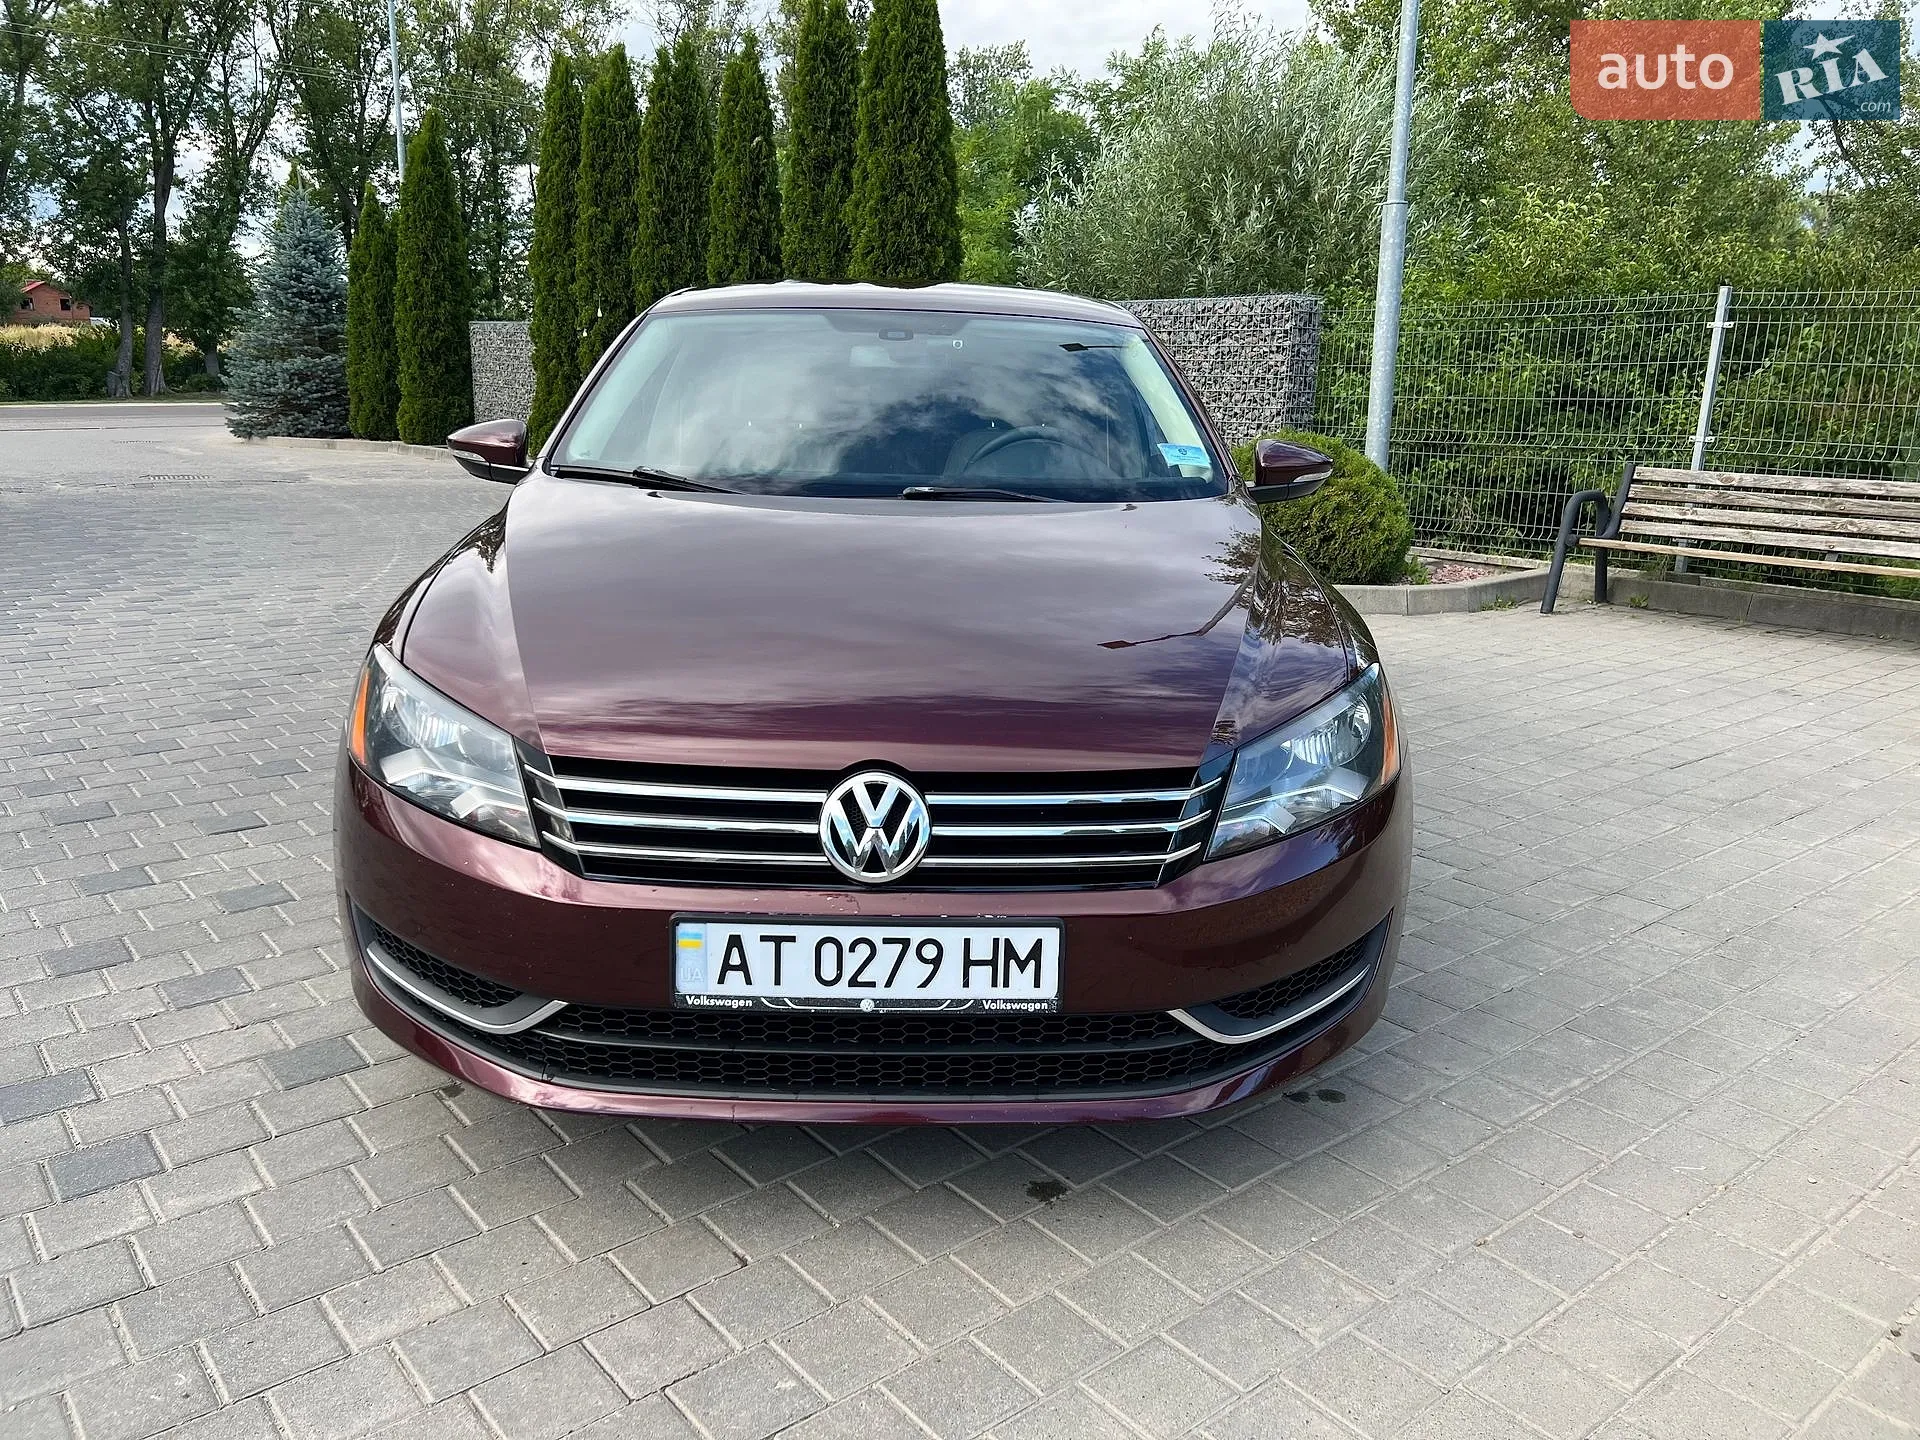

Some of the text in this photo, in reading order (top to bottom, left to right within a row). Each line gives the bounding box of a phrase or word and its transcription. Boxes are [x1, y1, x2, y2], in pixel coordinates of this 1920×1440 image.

[717, 934, 1043, 989] AT 0279 HM
[680, 967, 703, 982] UA
[685, 995, 753, 1008] Volkswagen
[982, 1000, 1048, 1012] Volkswagen
